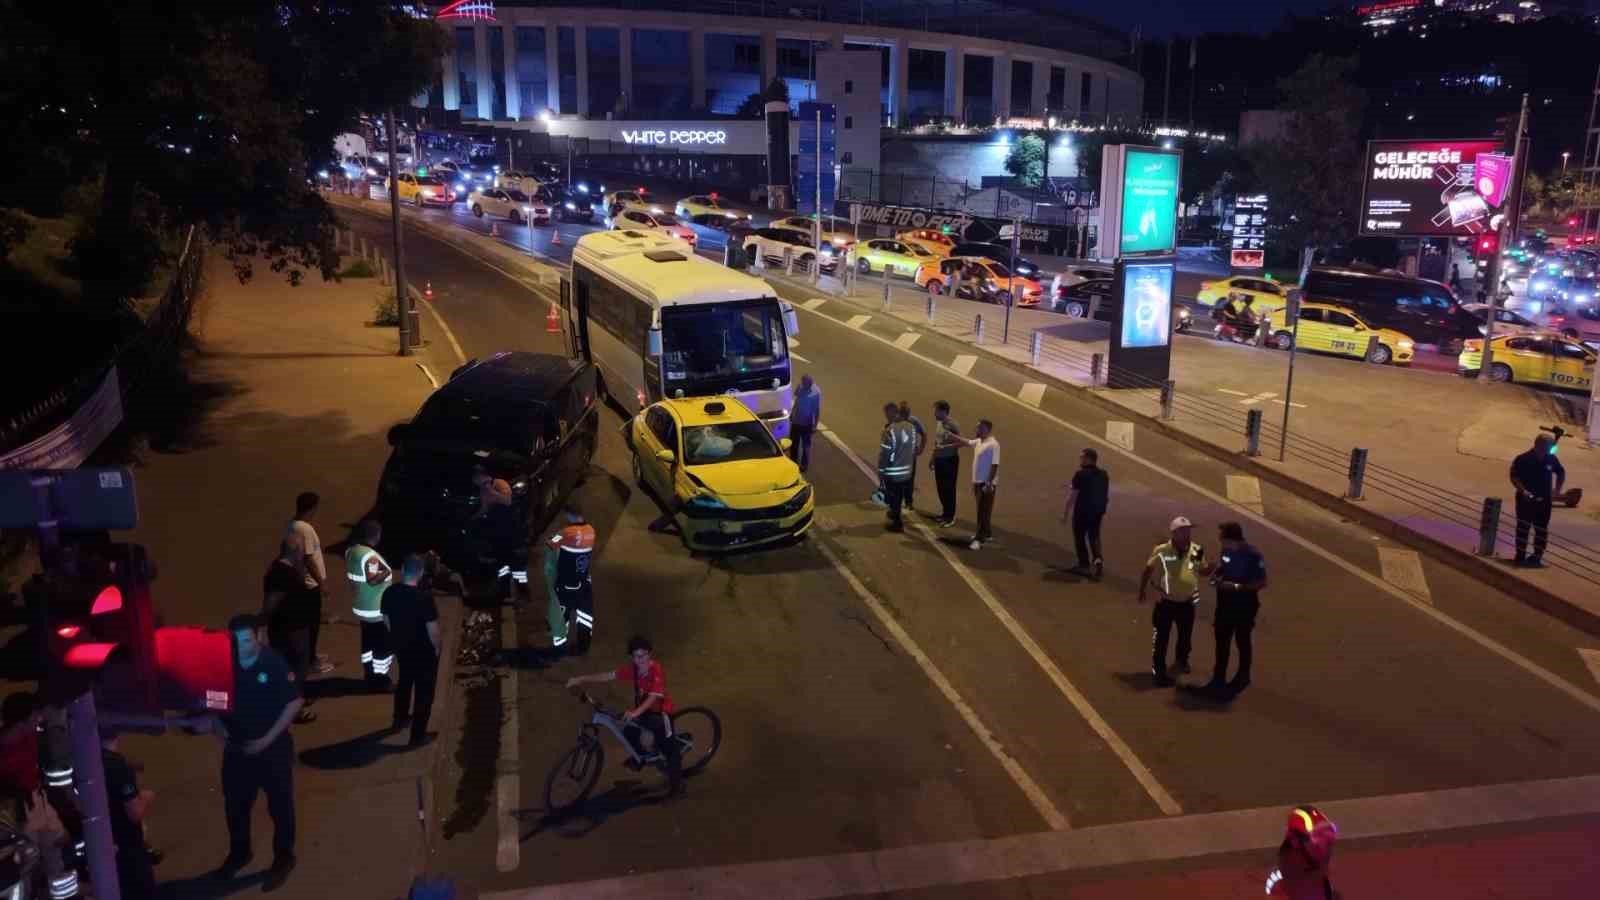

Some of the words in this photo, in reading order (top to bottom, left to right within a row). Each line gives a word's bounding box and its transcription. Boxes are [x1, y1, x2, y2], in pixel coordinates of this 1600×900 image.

[622, 130, 666, 144] WHITE
[670, 130, 726, 144] PEPPER
[1375, 148, 1461, 164] GELECEĞE
[1373, 165, 1433, 180] MÜHÜR
